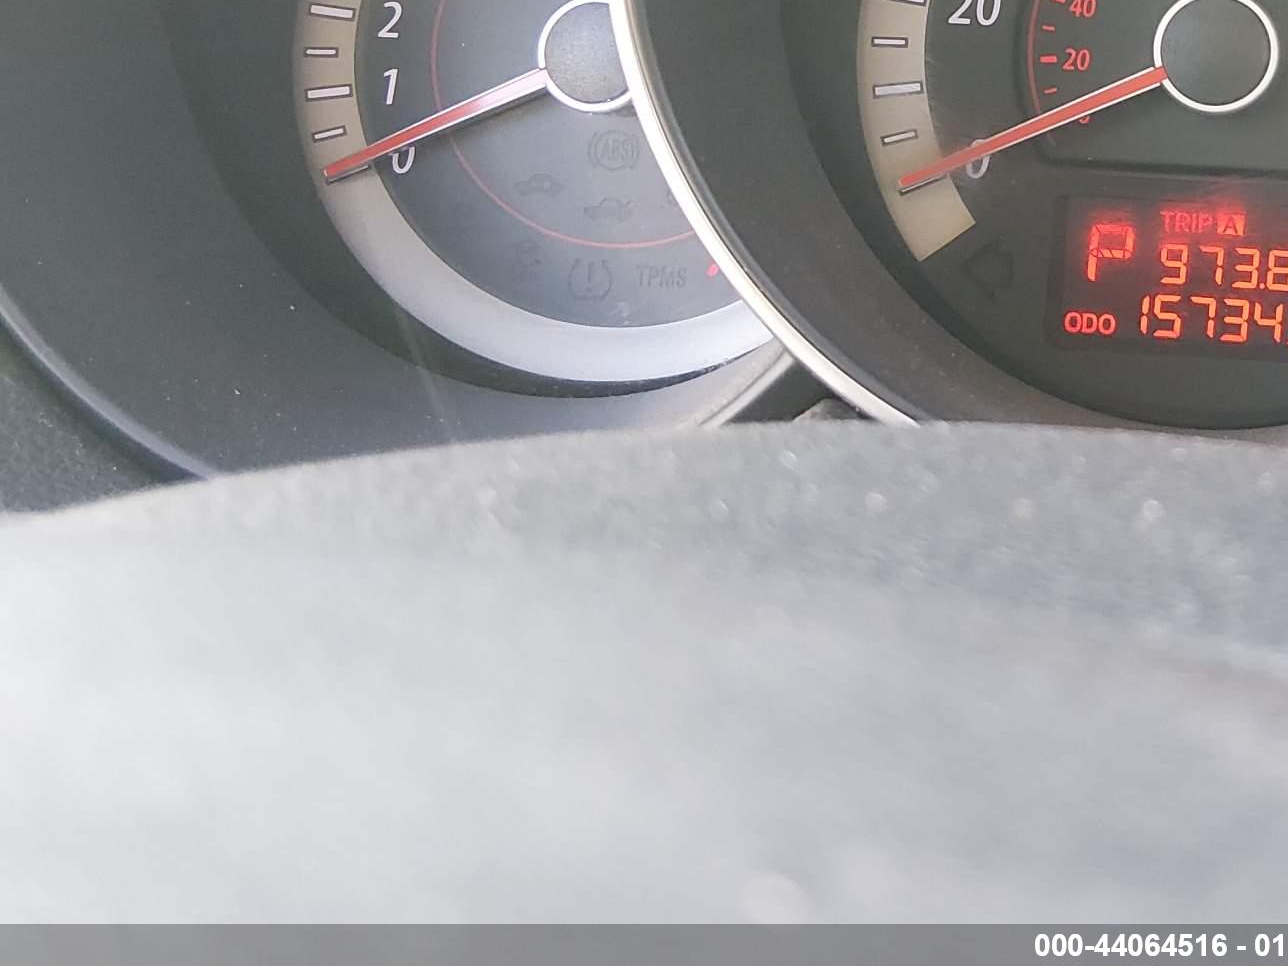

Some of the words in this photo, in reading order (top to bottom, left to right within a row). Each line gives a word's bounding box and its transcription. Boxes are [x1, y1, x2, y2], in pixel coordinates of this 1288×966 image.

[377, 2, 403, 38] 2
[1062, 49, 1090, 71] 20
[383, 68, 399, 104] 1
[1160, 211, 1213, 234] TRIP
[1087, 223, 1135, 282] P
[637, 265, 687, 289] TPMS
[1064, 312, 1116, 335] ODO
